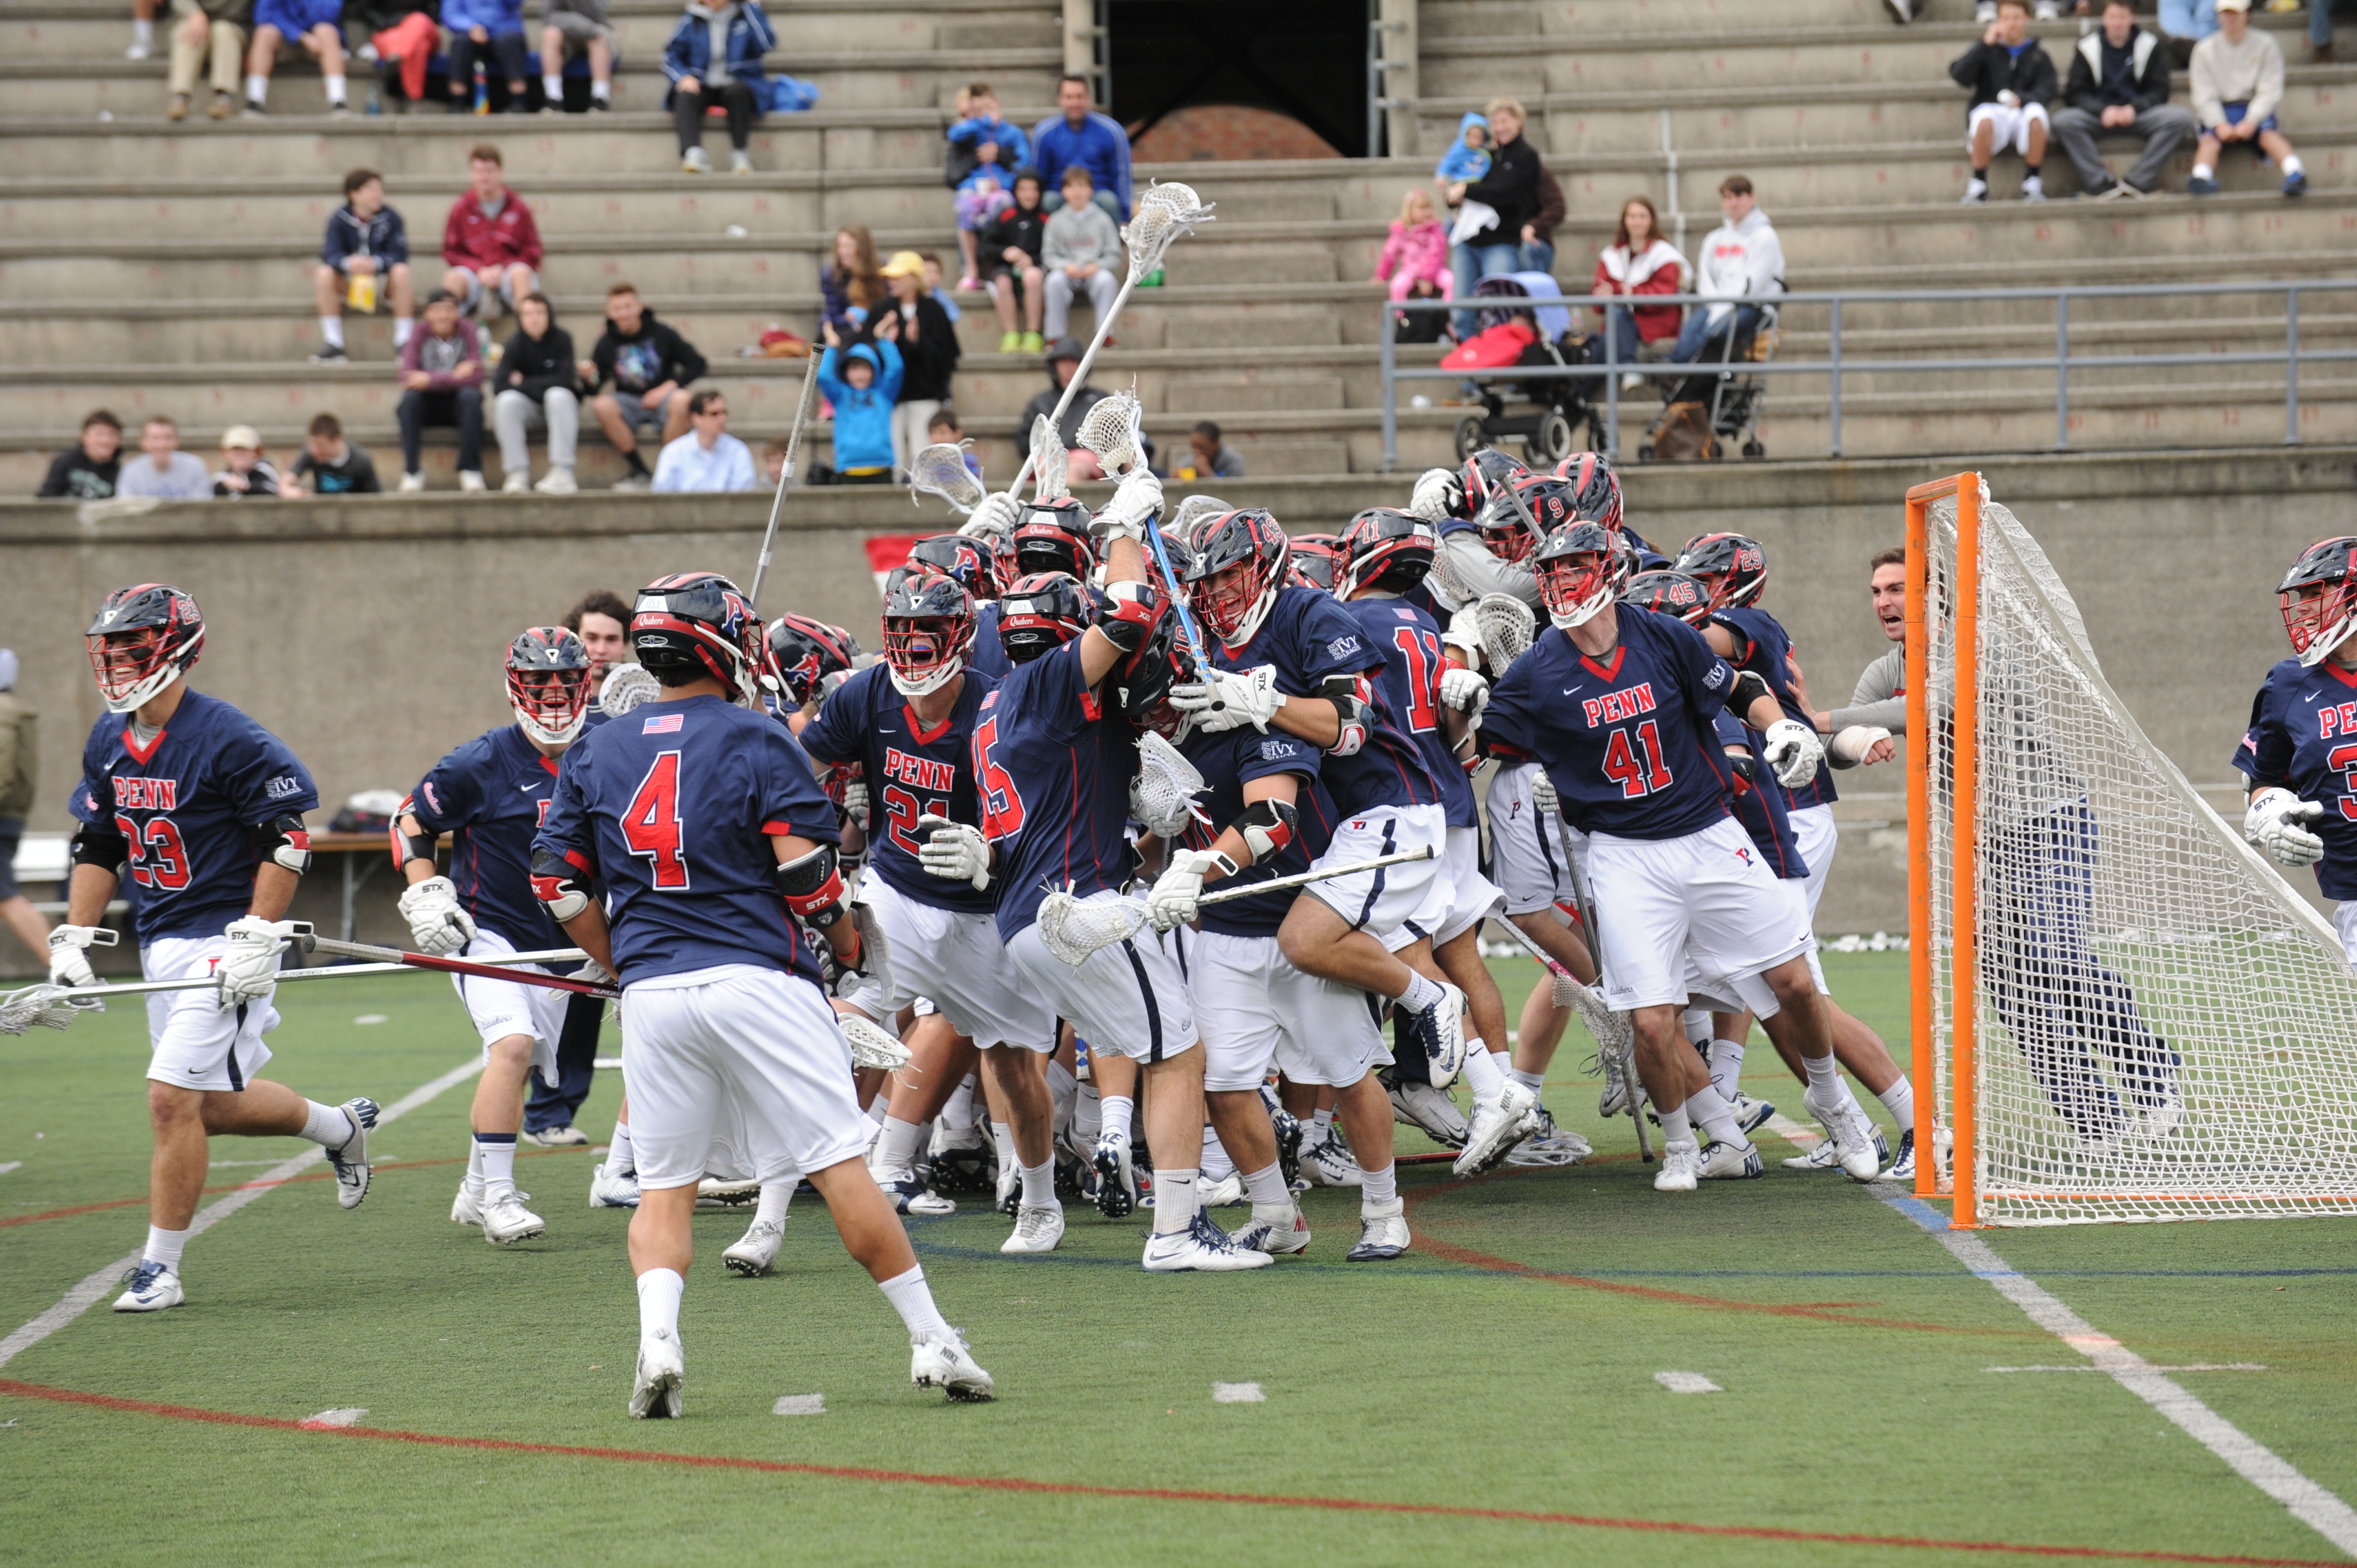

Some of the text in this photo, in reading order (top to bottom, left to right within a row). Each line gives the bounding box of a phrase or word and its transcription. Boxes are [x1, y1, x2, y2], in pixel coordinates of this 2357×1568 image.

[1547, 496, 1565, 519] 9
[1261, 517, 1283, 545] 43
[1362, 520, 1381, 544] 11
[1740, 549, 1762, 572] 29
[1669, 581, 1697, 606] 45
[178, 597, 202, 625] 23
[639, 614, 666, 627] Quakers
[1137, 610, 1151, 622] STX
[1010, 616, 1034, 627] Quakers
[1337, 635, 1358, 654] IVY
[1342, 644, 1362, 658] LEAGUE
[1258, 672, 1267, 692] STX
[1582, 682, 1657, 729] PENN
[1784, 725, 1805, 733] STX
[2318, 701, 2357, 740] PE
[1270, 744, 1294, 756] IVY
[1601, 719, 1673, 799] 41
[884, 746, 955, 792] PENN
[971, 715, 1025, 843] 5
[111, 775, 177, 811] PENN
[275, 776, 297, 793] IVY
[276, 787, 303, 799] LEAGUE
[1509, 801, 1521, 820] P
[2253, 793, 2277, 813] STX
[620, 750, 689, 890] 4
[114, 812, 193, 890] 23
[1735, 847, 1754, 868] P
[421, 884, 444, 894] STX
[531, 884, 542, 895] TX
[806, 893, 830, 910] STX
[50, 933, 68, 946] STX
[231, 931, 250, 940] STX
[278, 969, 324, 978] SURGEON
[1610, 986, 1634, 996] Quakers
[1499, 1087, 1515, 1113] NIKE
[939, 1345, 960, 1368] NIKE
